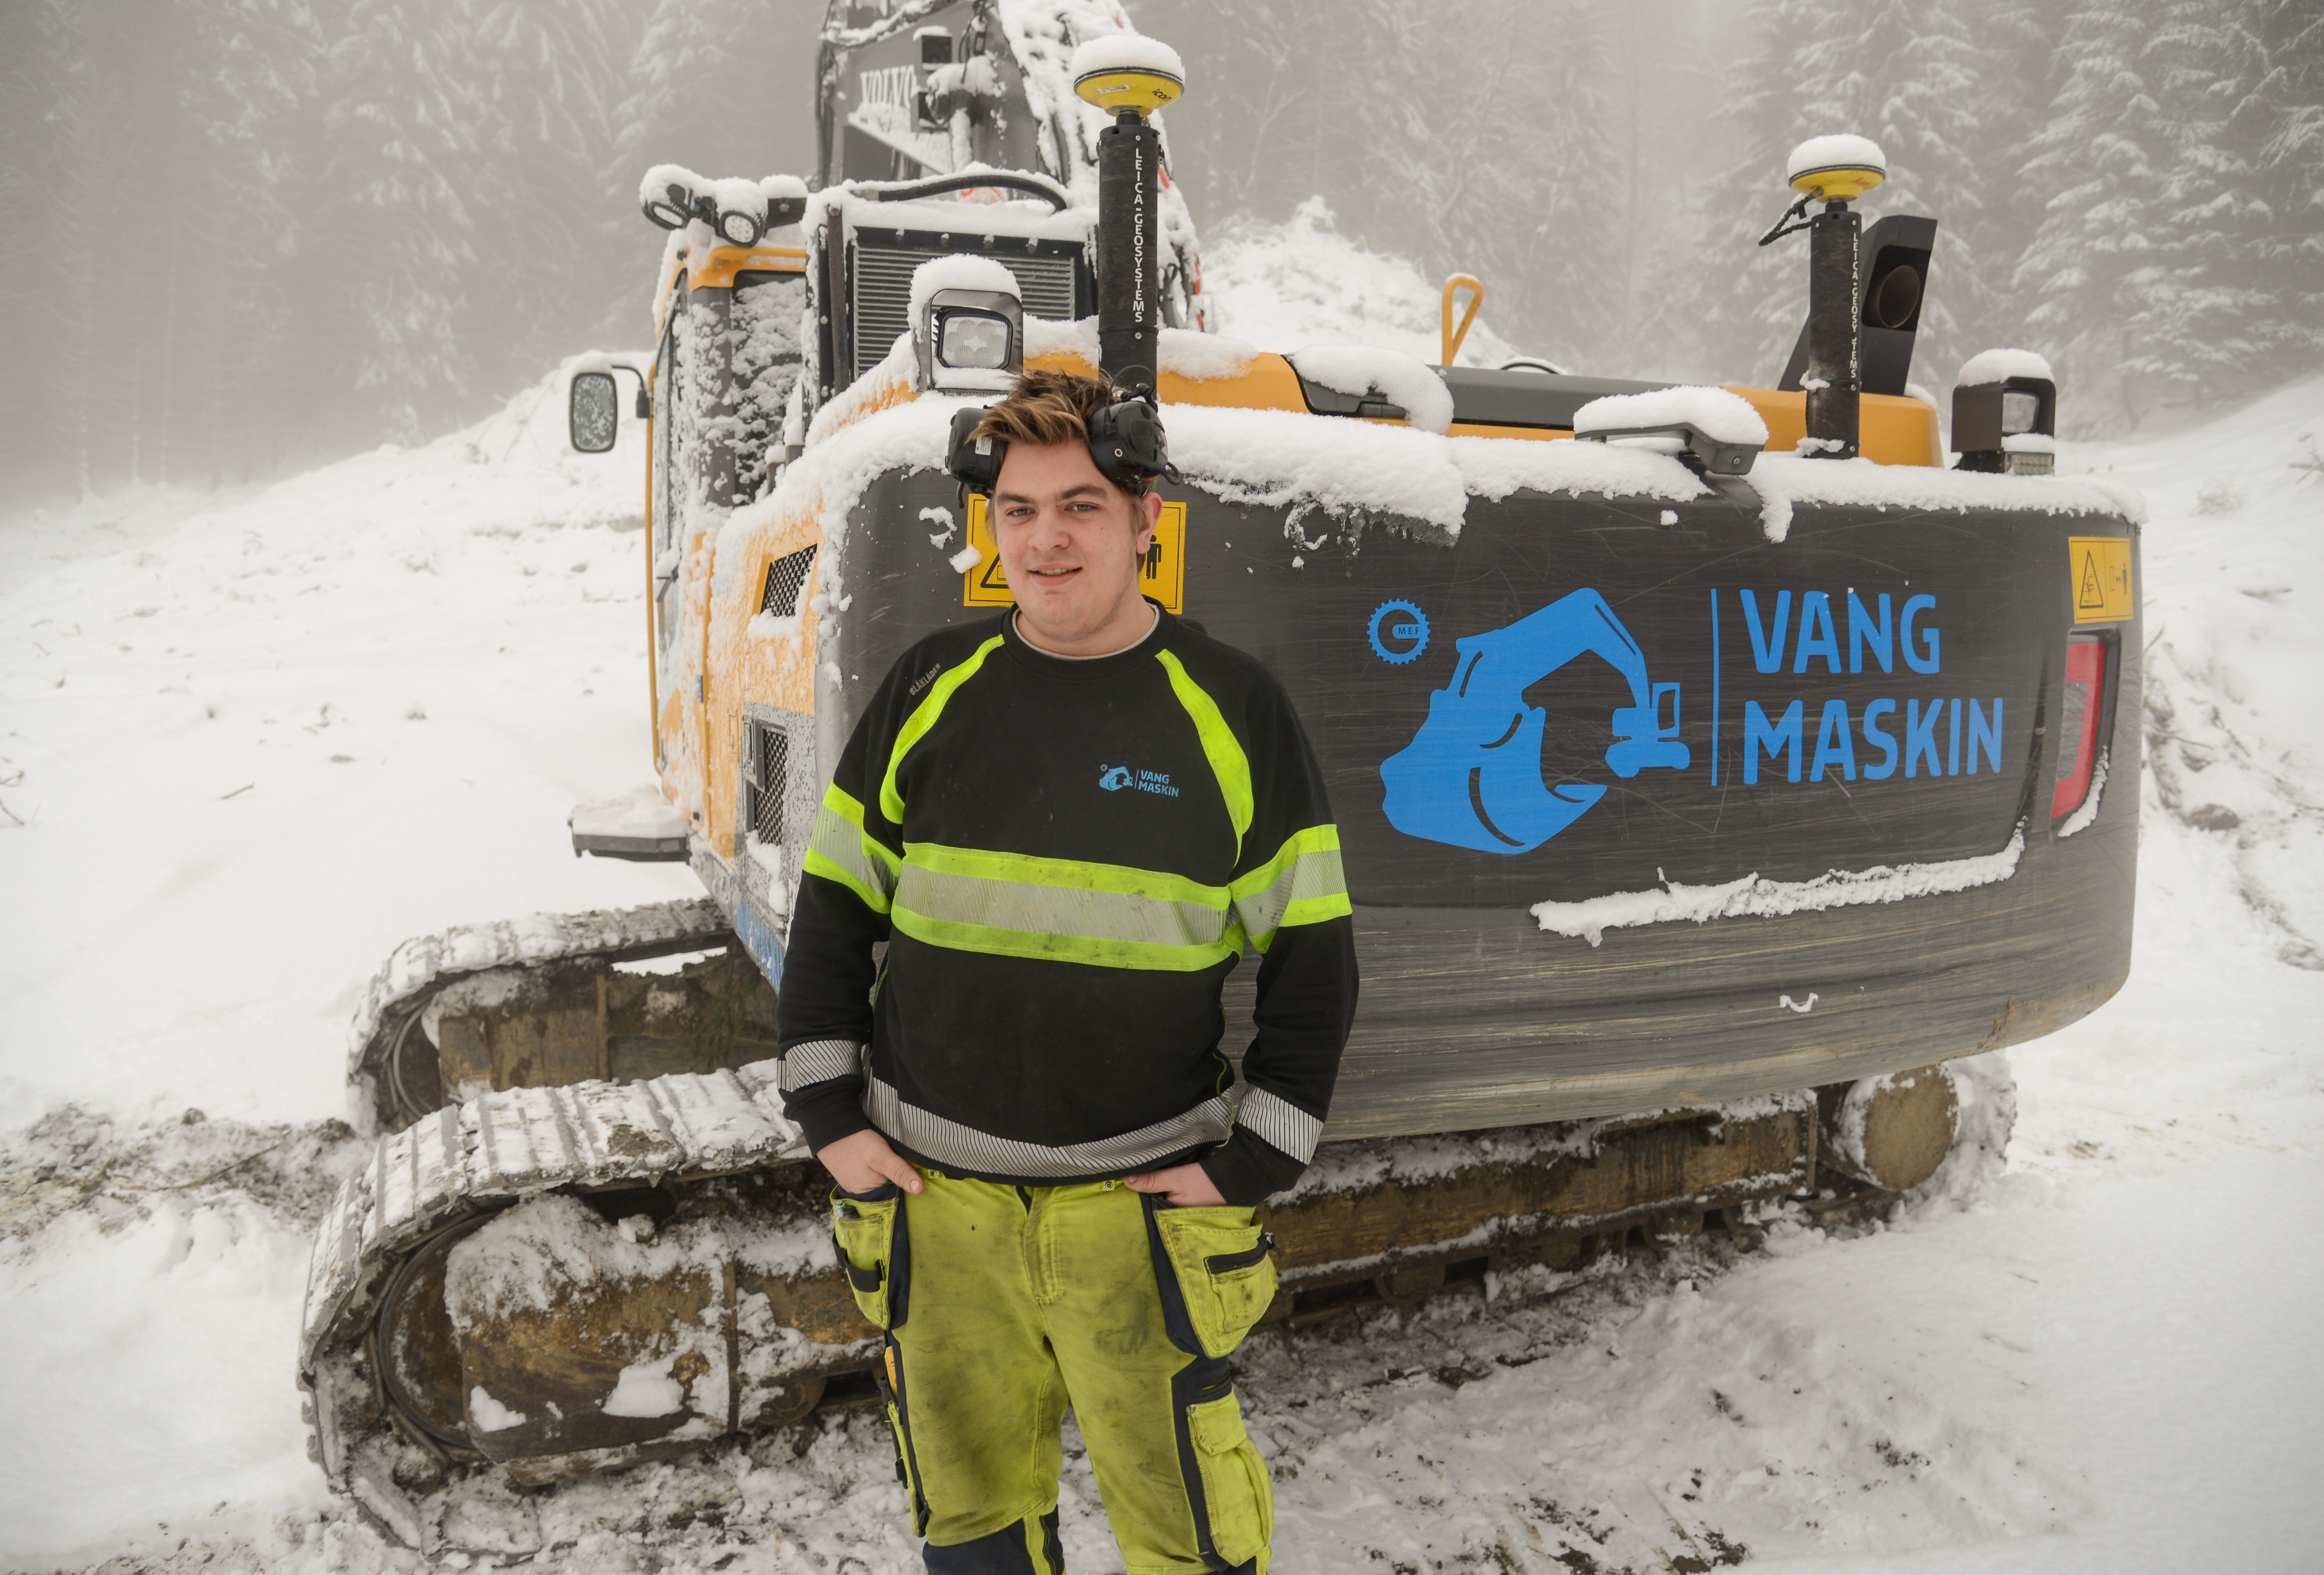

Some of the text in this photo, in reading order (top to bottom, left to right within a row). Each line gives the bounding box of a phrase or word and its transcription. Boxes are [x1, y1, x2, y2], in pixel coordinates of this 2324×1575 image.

[1740, 589, 1939, 674] VANG
[910, 663, 940, 696] BLÅKLÄDER
[1743, 698, 2003, 784] MASKIN
[1138, 781, 1179, 797] MASKIN
[1141, 770, 1169, 784] VANG
